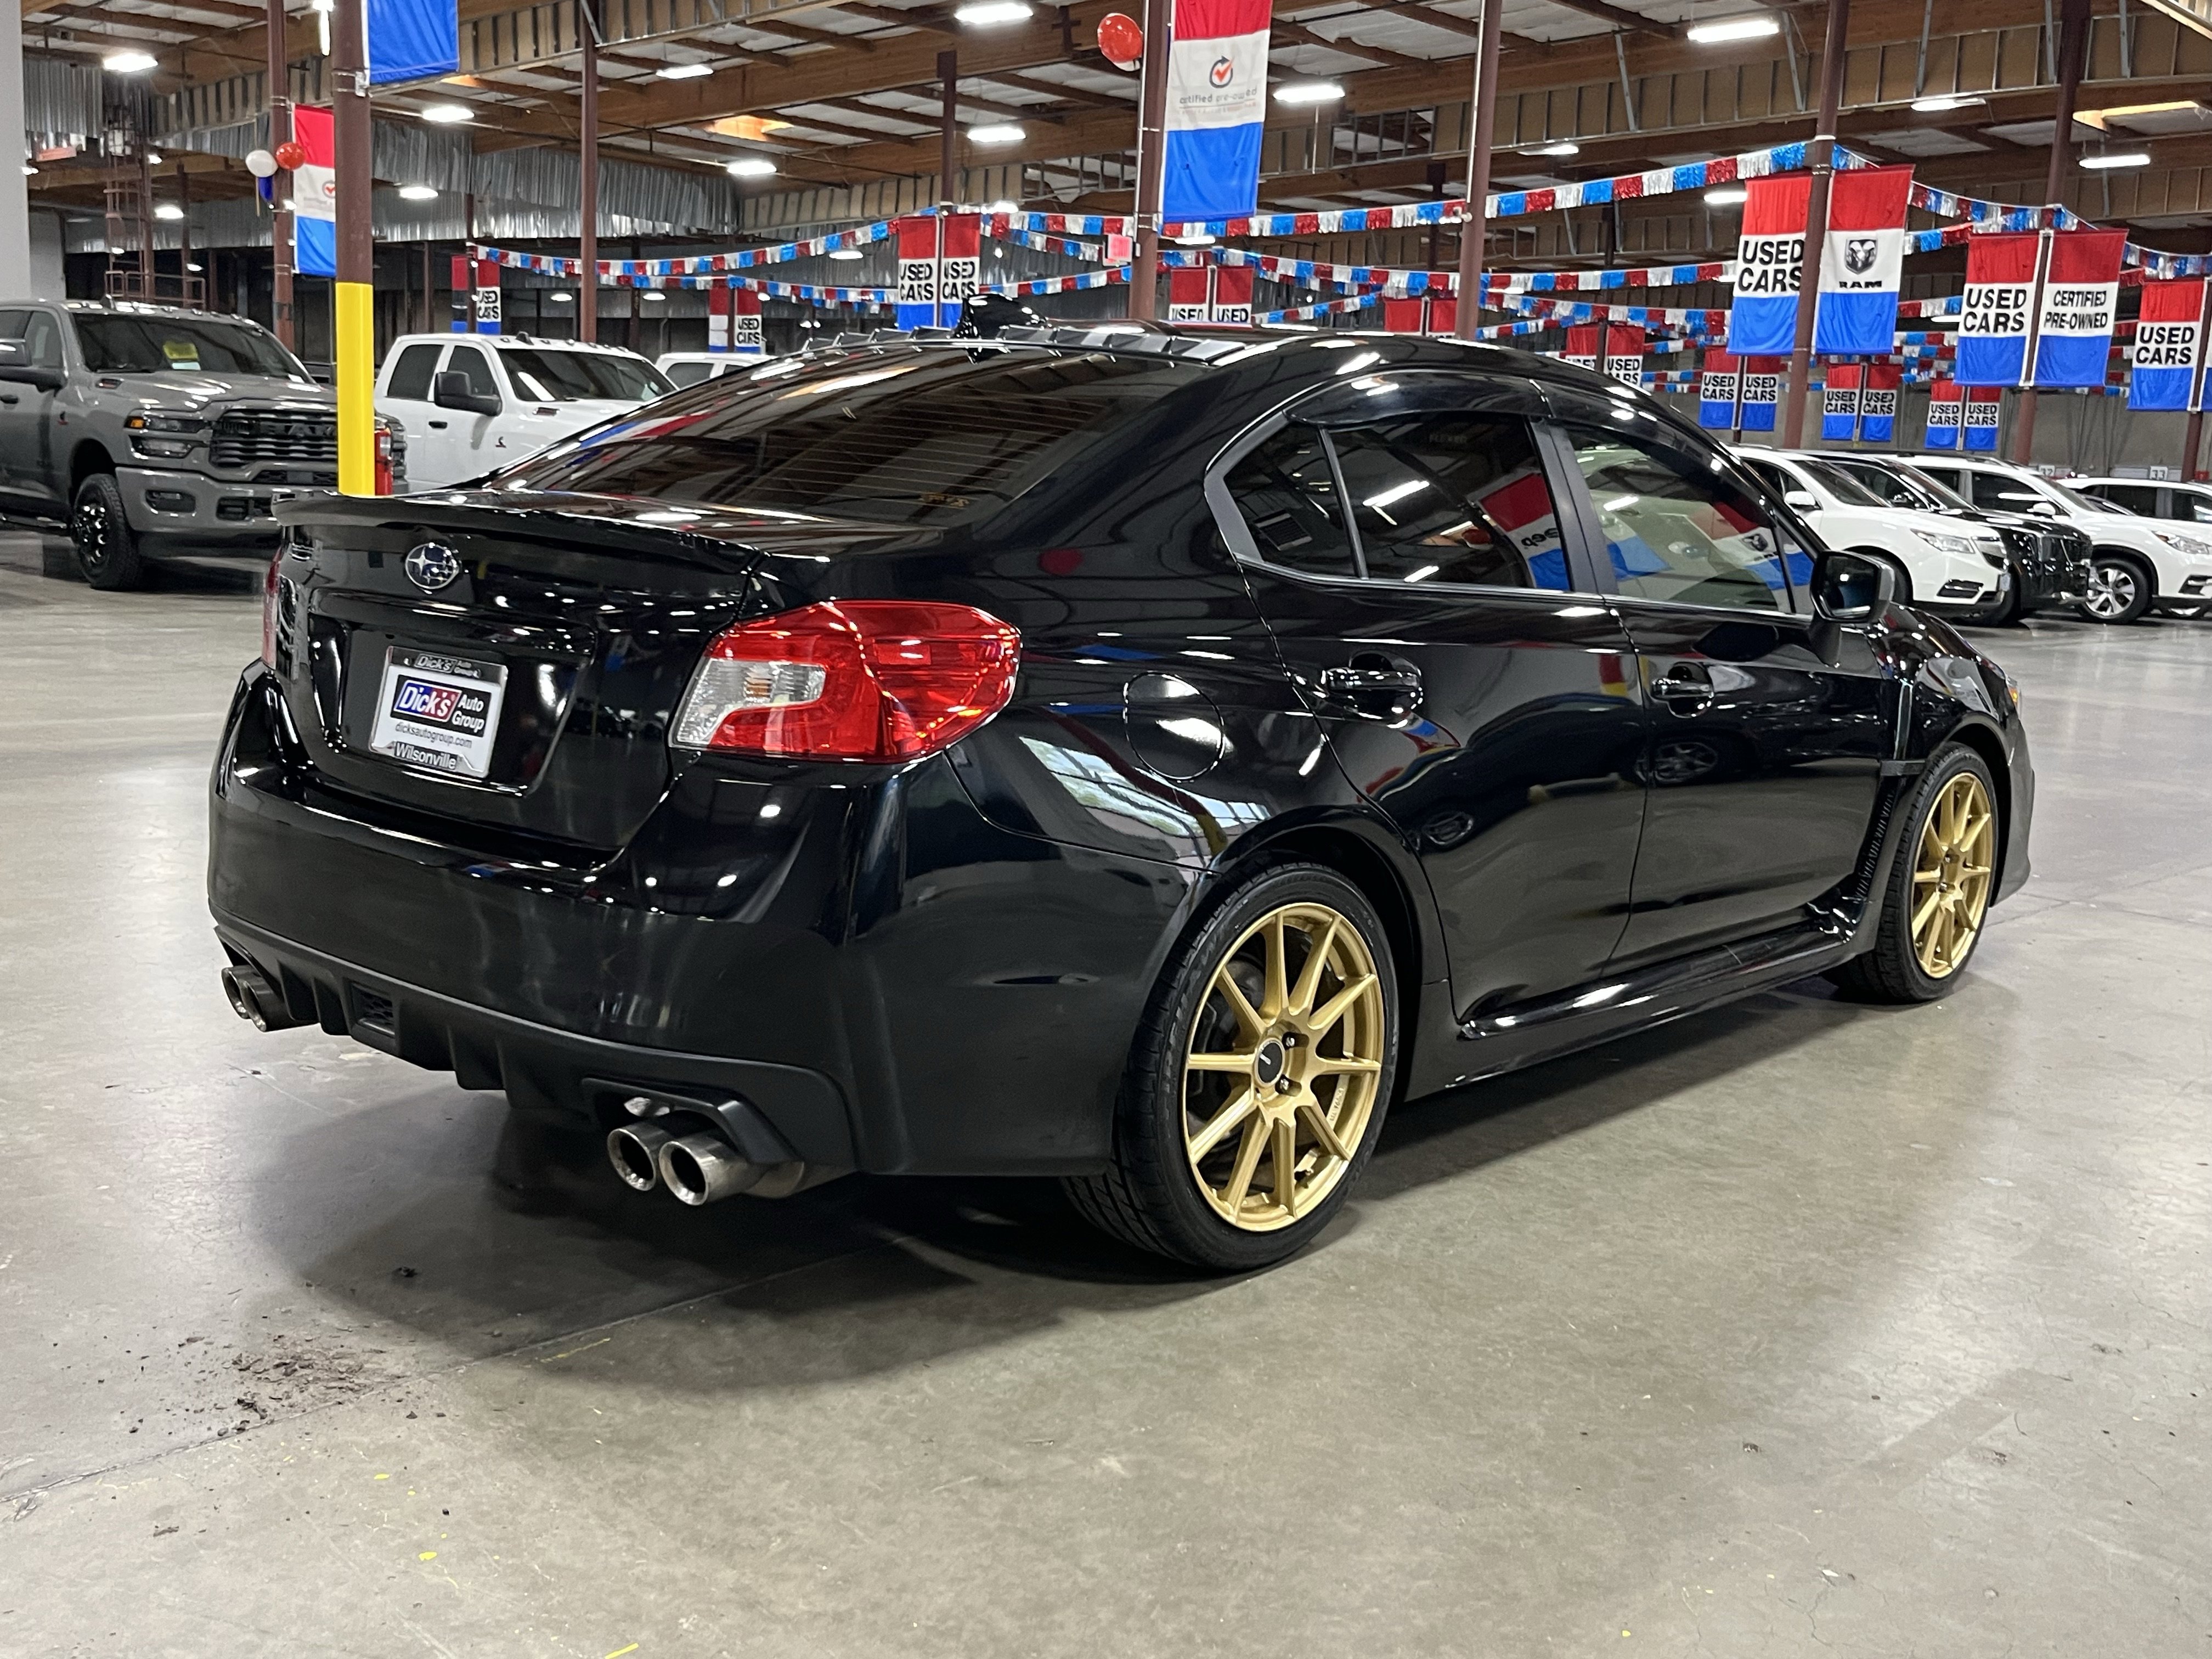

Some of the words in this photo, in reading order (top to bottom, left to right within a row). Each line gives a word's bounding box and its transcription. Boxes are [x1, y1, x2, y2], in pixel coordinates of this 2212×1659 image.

[1742, 239, 1805, 264] USED
[900, 263, 933, 281] USED
[944, 261, 975, 279] USED
[1738, 267, 1802, 292] CARS
[1966, 288, 2027, 309] USED
[2053, 290, 2107, 307] CERTIFIED
[1963, 311, 2024, 333] CARS
[2044, 311, 2108, 329] PRE-OWNED
[2140, 326, 2194, 345] USED
[2136, 346, 2192, 365] CARS
[1607, 358, 1640, 371] USED
[1704, 375, 1735, 387] USED
[1746, 376, 1776, 388] USED
[1702, 387, 1734, 400] CARS
[1743, 389, 1776, 402] CARS
[1826, 391, 1857, 402] USED
[1865, 391, 1894, 403] USED
[1825, 403, 1855, 414] CARS
[1931, 404, 1959, 414] USED
[1968, 404, 1997, 415] USED
[1929, 415, 1959, 426] CARS
[1967, 415, 1996, 426] CARS
[417, 656, 452, 671] Dick's
[399, 686, 452, 716] Dick's
[458, 694, 484, 712] Auto
[452, 711, 485, 733] Group
[395, 721, 472, 749] dicksautogroup.com
[395, 742, 456, 770] Wilsonville
